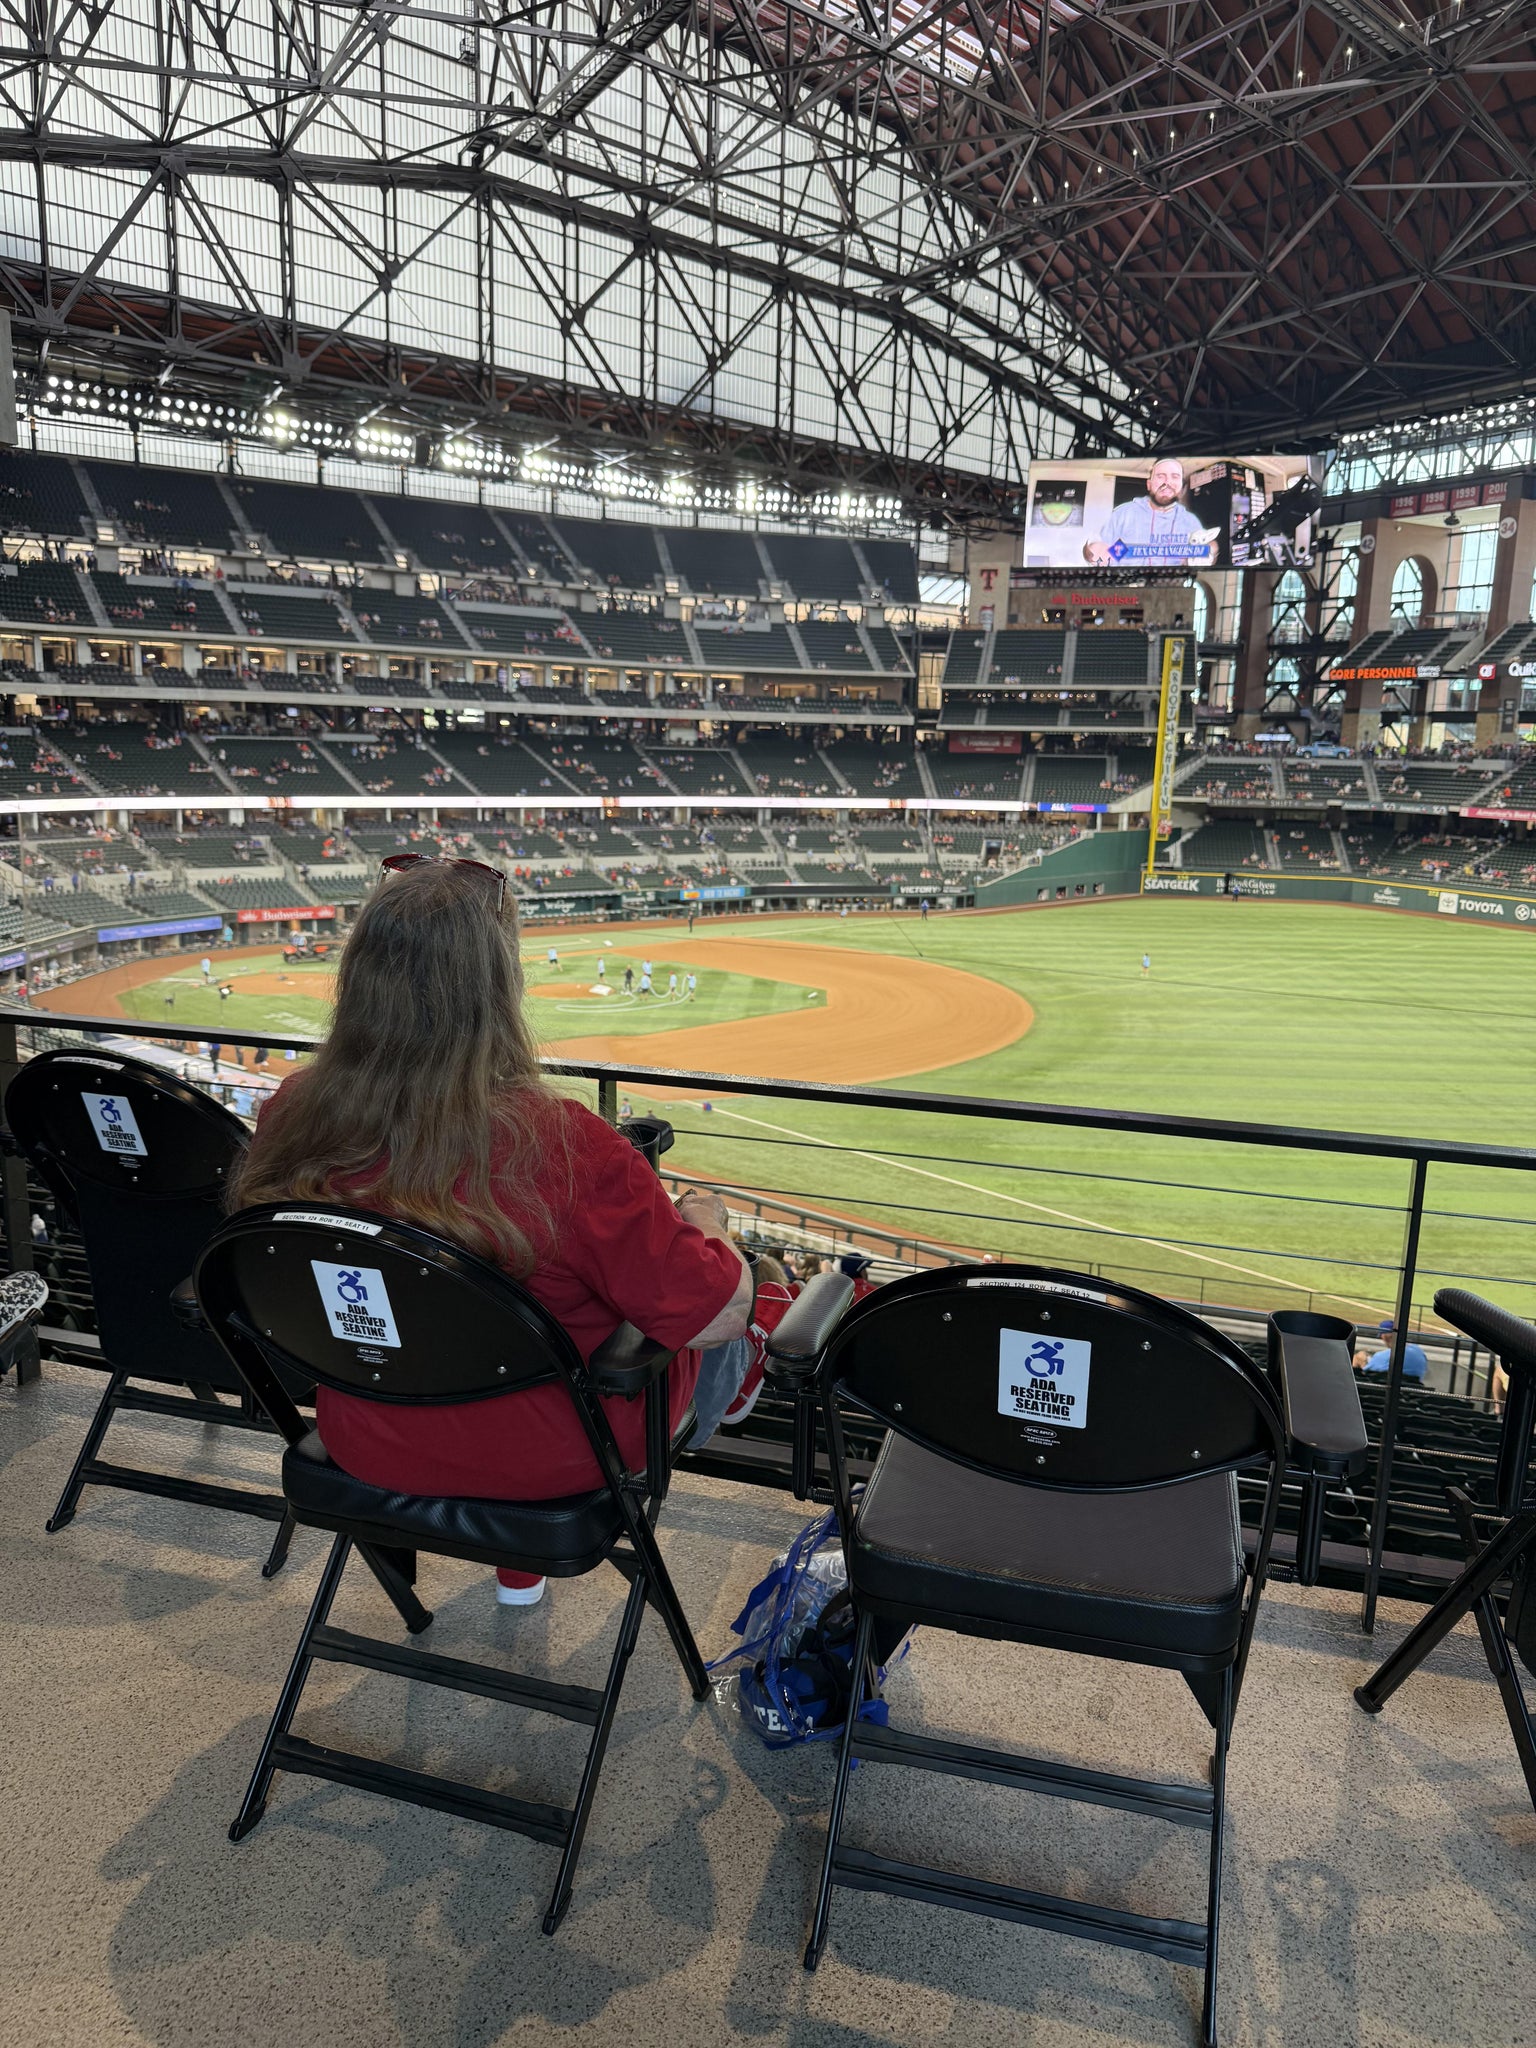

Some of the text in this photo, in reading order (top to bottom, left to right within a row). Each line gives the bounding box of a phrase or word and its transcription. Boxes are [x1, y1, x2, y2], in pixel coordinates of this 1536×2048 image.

[1456, 487, 1476, 498] 1999
[1501, 521, 1516, 534] 34
[1362, 538, 1373, 550] 42
[980, 569, 998, 591] T
[1071, 594, 1138, 606] Budweiser
[1329, 666, 1417, 681] CORE PERSONNEL
[1160, 740, 1174, 808] CHIKIN
[900, 886, 938, 894] VICTORY
[1144, 878, 1200, 892] SEATGEEK
[1459, 900, 1504, 915] TOYOTA
[262, 908, 314, 920] Budweiser
[108, 1124, 124, 1132] ADA
[101, 1130, 136, 1141] RESERVED
[106, 1138, 137, 1149] SEATING
[344, 1221, 361, 1229] SEAT
[1060, 1288, 1080, 1298] SEAT
[347, 1304, 369, 1316] ADA
[334, 1311, 386, 1328] RESERVED
[342, 1322, 386, 1338] SEATING
[1030, 1378, 1056, 1392] ADA
[1010, 1384, 1075, 1406] RESERVED
[1015, 1398, 1070, 1416] SEATING
